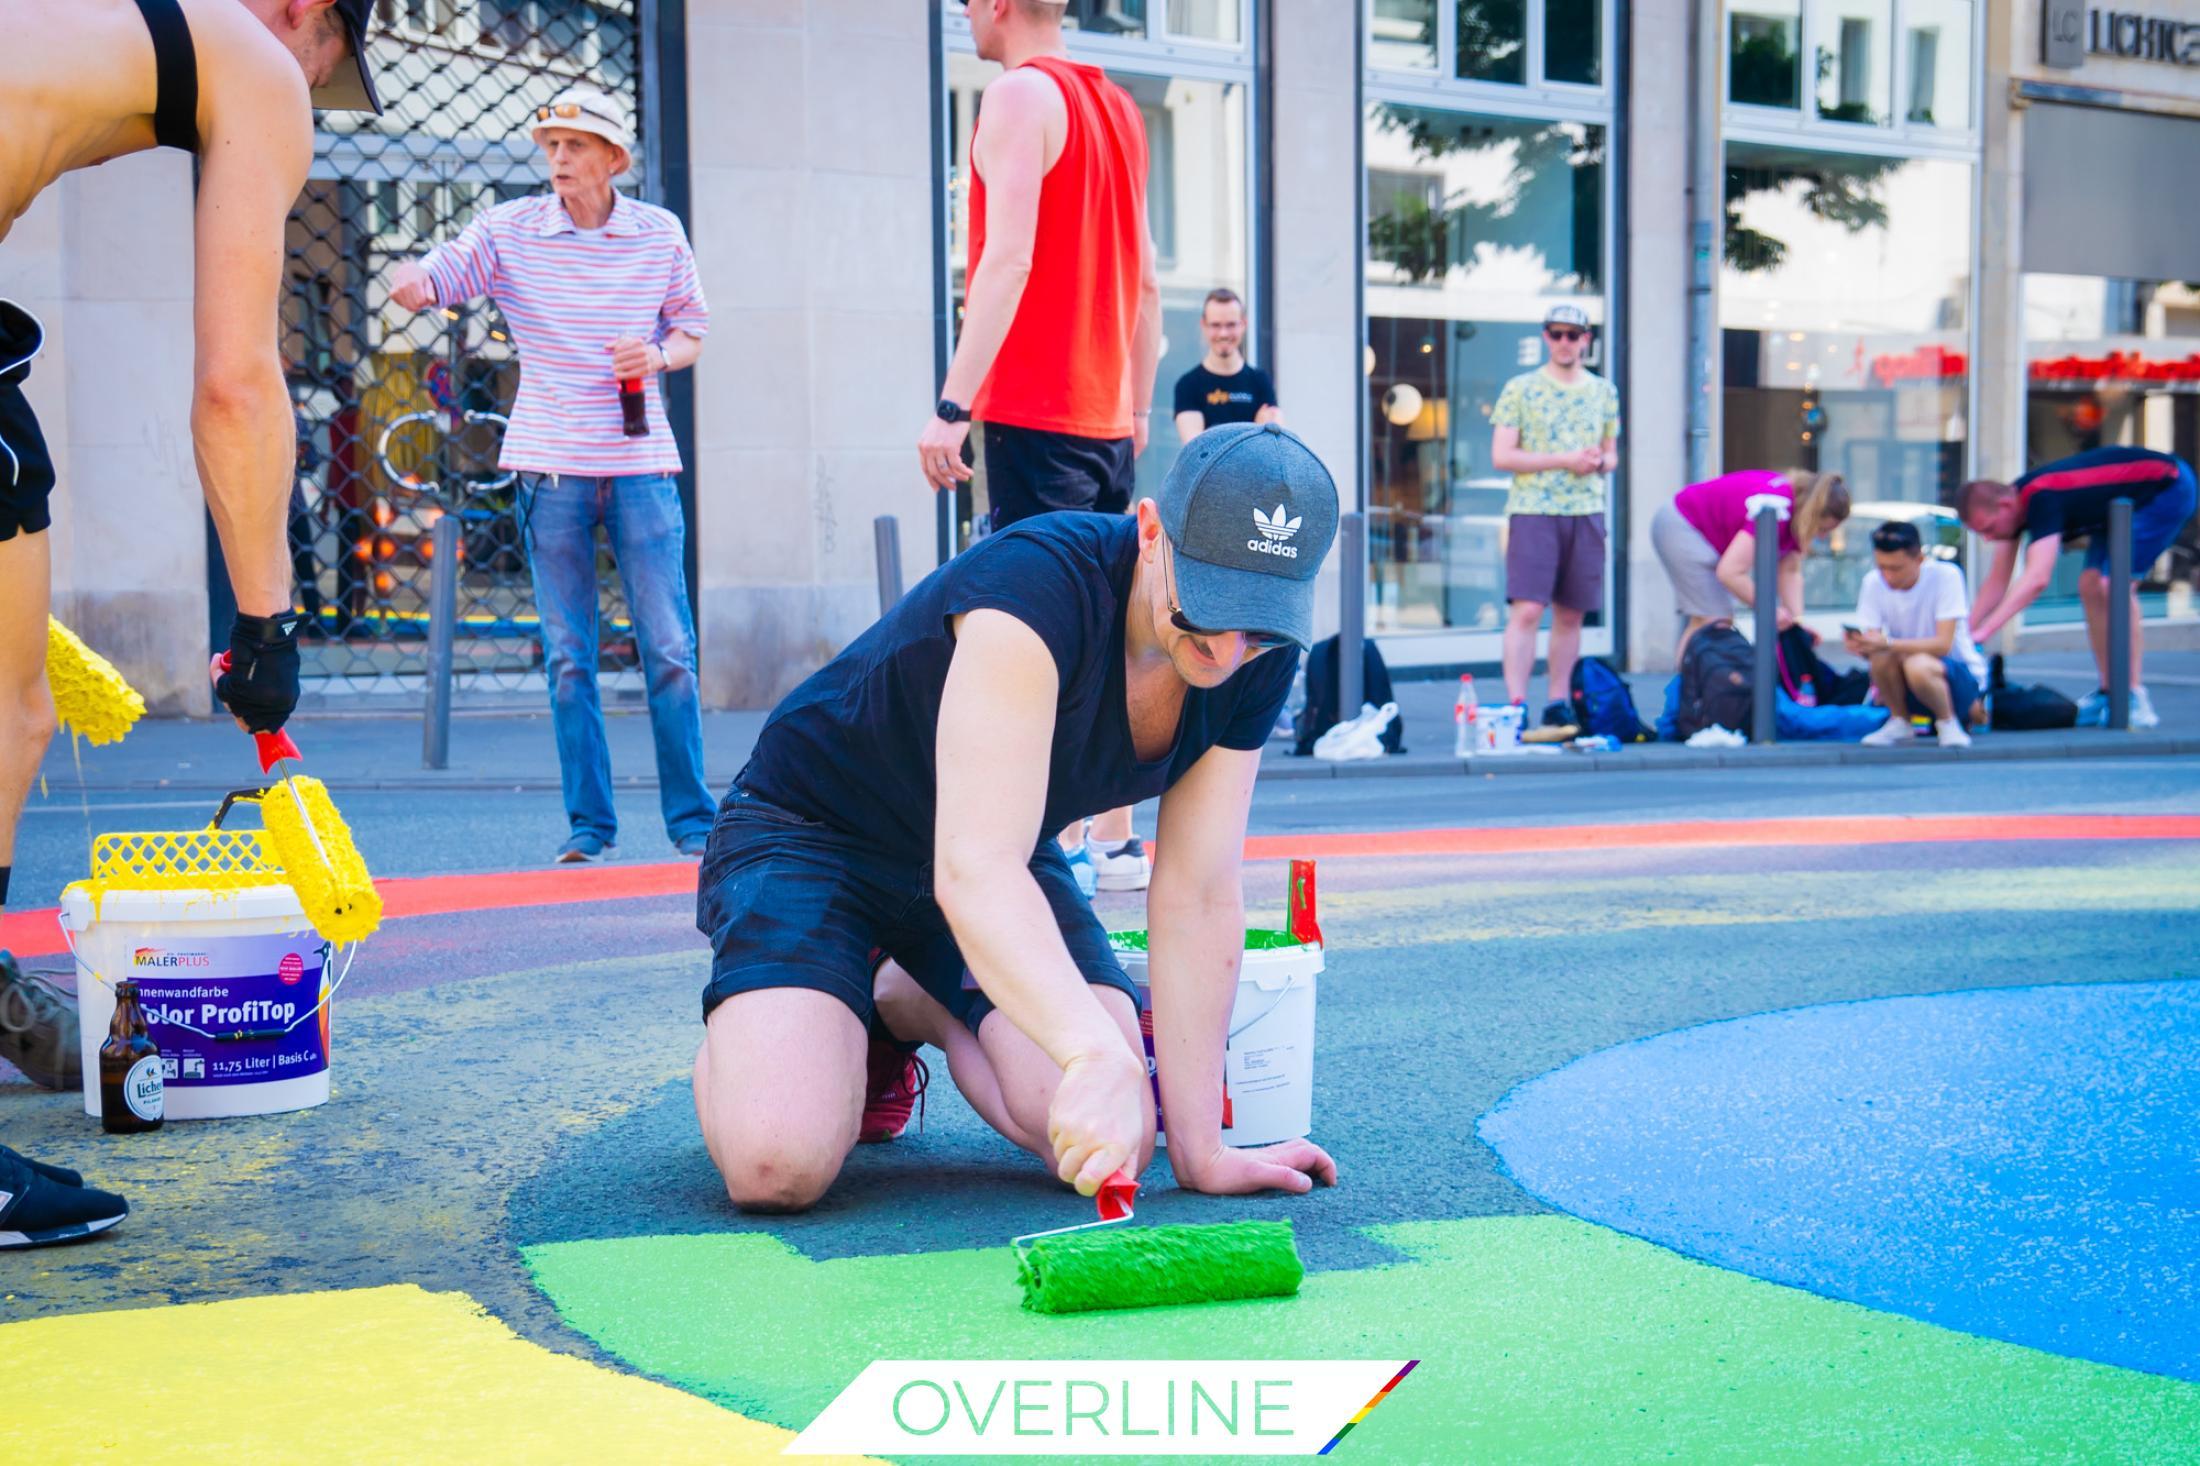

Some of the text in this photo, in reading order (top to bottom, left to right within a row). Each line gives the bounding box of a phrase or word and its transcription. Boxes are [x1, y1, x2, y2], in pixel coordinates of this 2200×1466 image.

[1247, 539, 1298, 559] adidas
[135, 955, 210, 967] MALERPLUS
[139, 986, 229, 998] nnenwandfarbe
[143, 1000, 296, 1025] olor ProfiTop
[212, 1061, 242, 1072] 11,75
[245, 1057, 271, 1069] Liter
[278, 1052, 302, 1066] Basis
